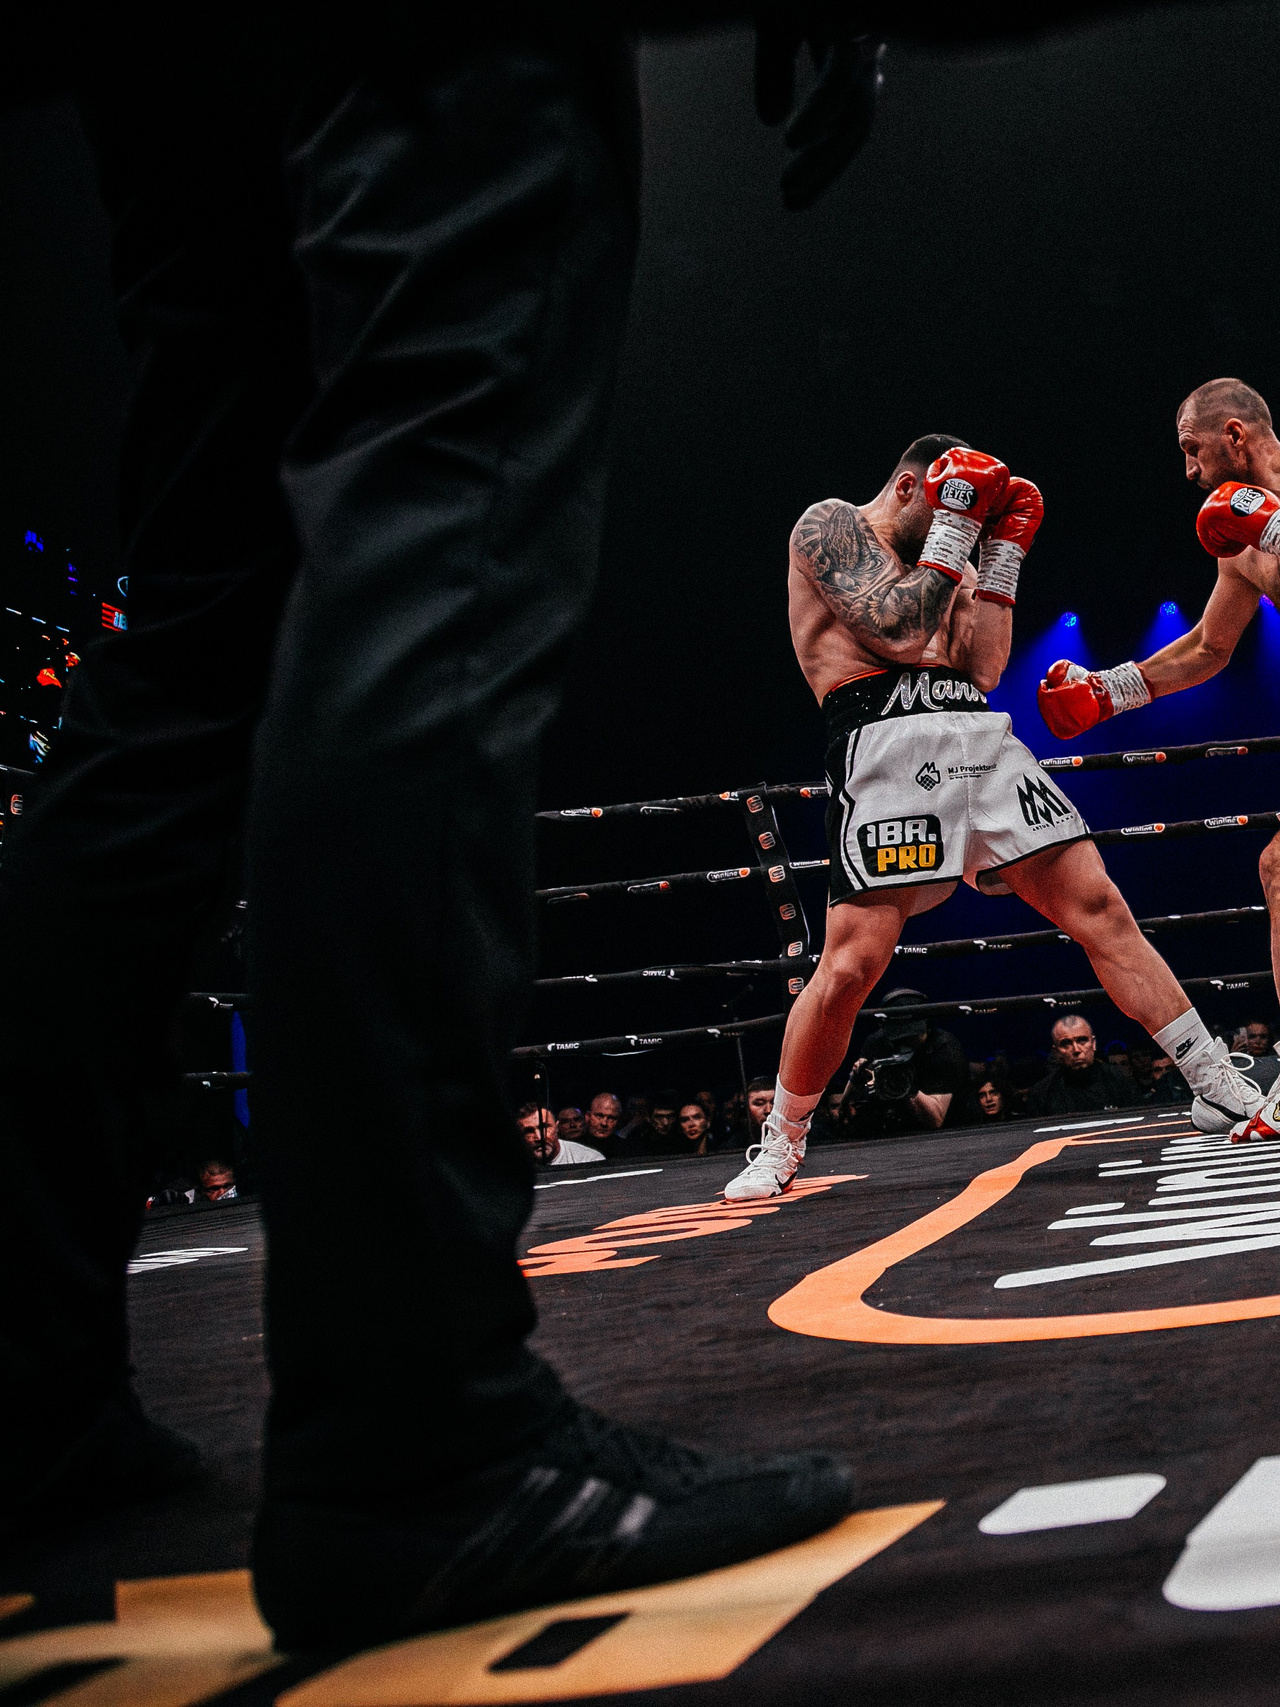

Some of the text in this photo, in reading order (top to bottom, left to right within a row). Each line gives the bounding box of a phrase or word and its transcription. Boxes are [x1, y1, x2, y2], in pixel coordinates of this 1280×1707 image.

[941, 483, 973, 505] REYES
[1234, 489, 1262, 515] REYES
[877, 844, 936, 872] PRO
[903, 946, 928, 954] TAMIC
[1225, 981, 1249, 990] TAMIC
[639, 1037, 663, 1046] TAMIC
[555, 1042, 580, 1051] TAMIC
